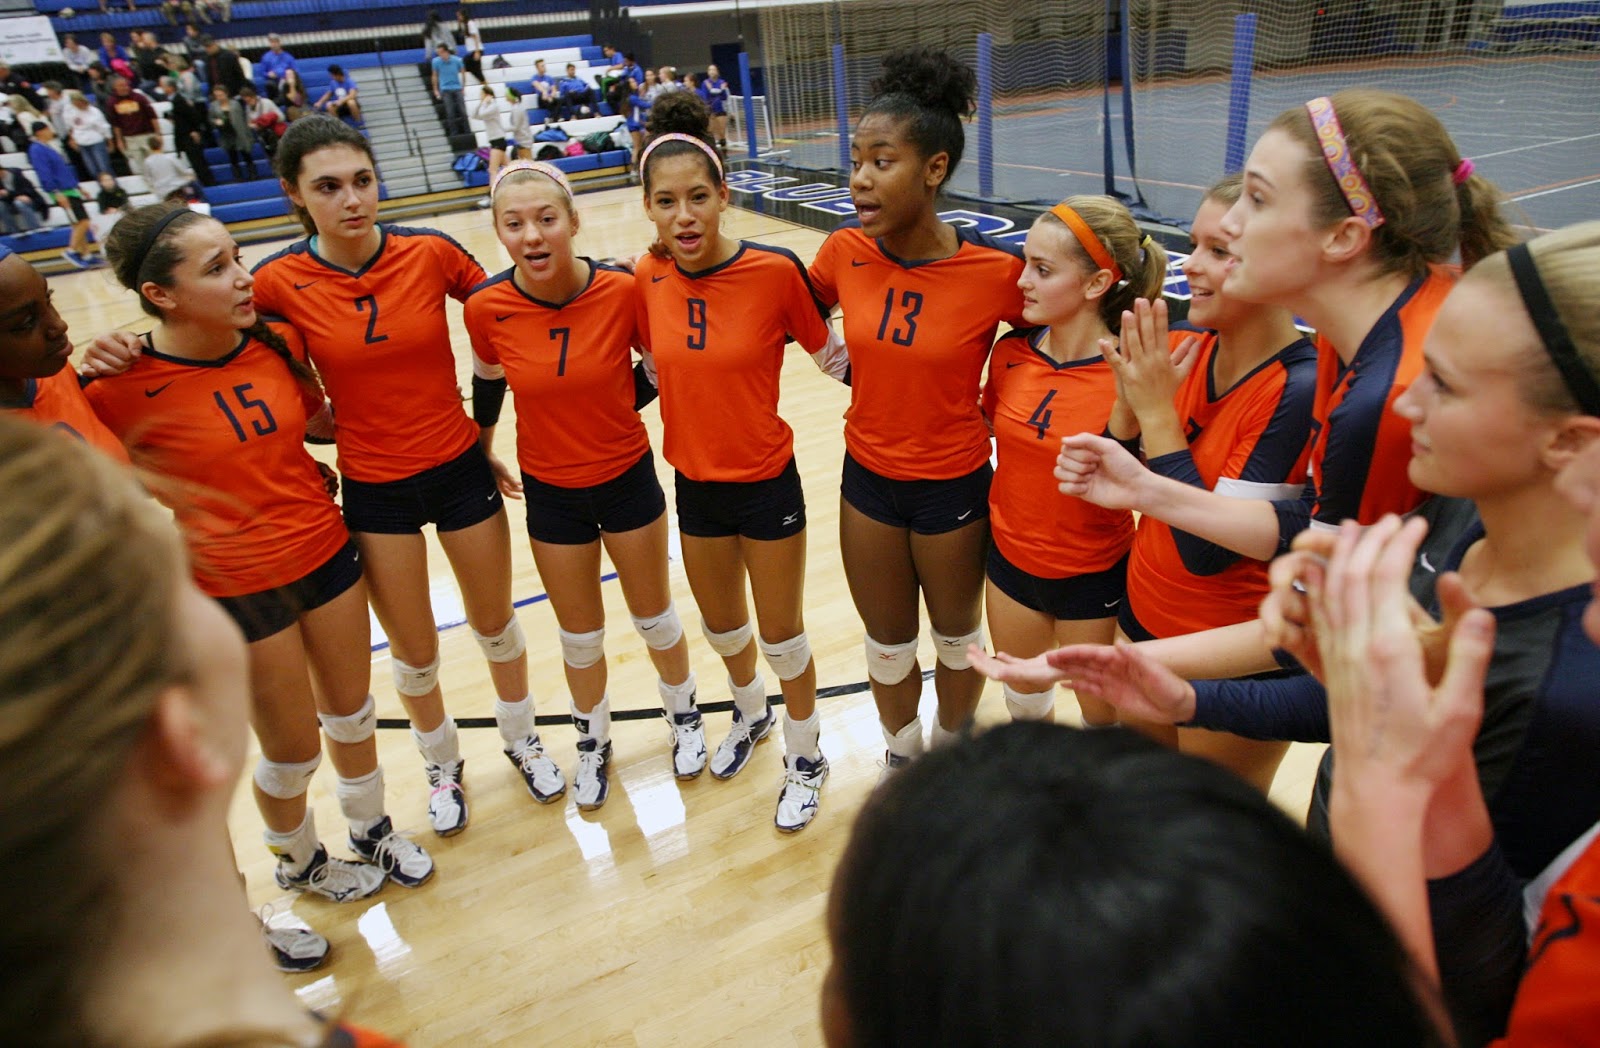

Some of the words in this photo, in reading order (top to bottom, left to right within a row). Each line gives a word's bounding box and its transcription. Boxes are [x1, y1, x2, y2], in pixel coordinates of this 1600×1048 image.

[352, 291, 390, 346] 2
[686, 297, 708, 351] 9
[876, 287, 924, 348] 13
[548, 326, 571, 377] 7
[212, 382, 279, 443] 15
[1027, 389, 1058, 441] 4
